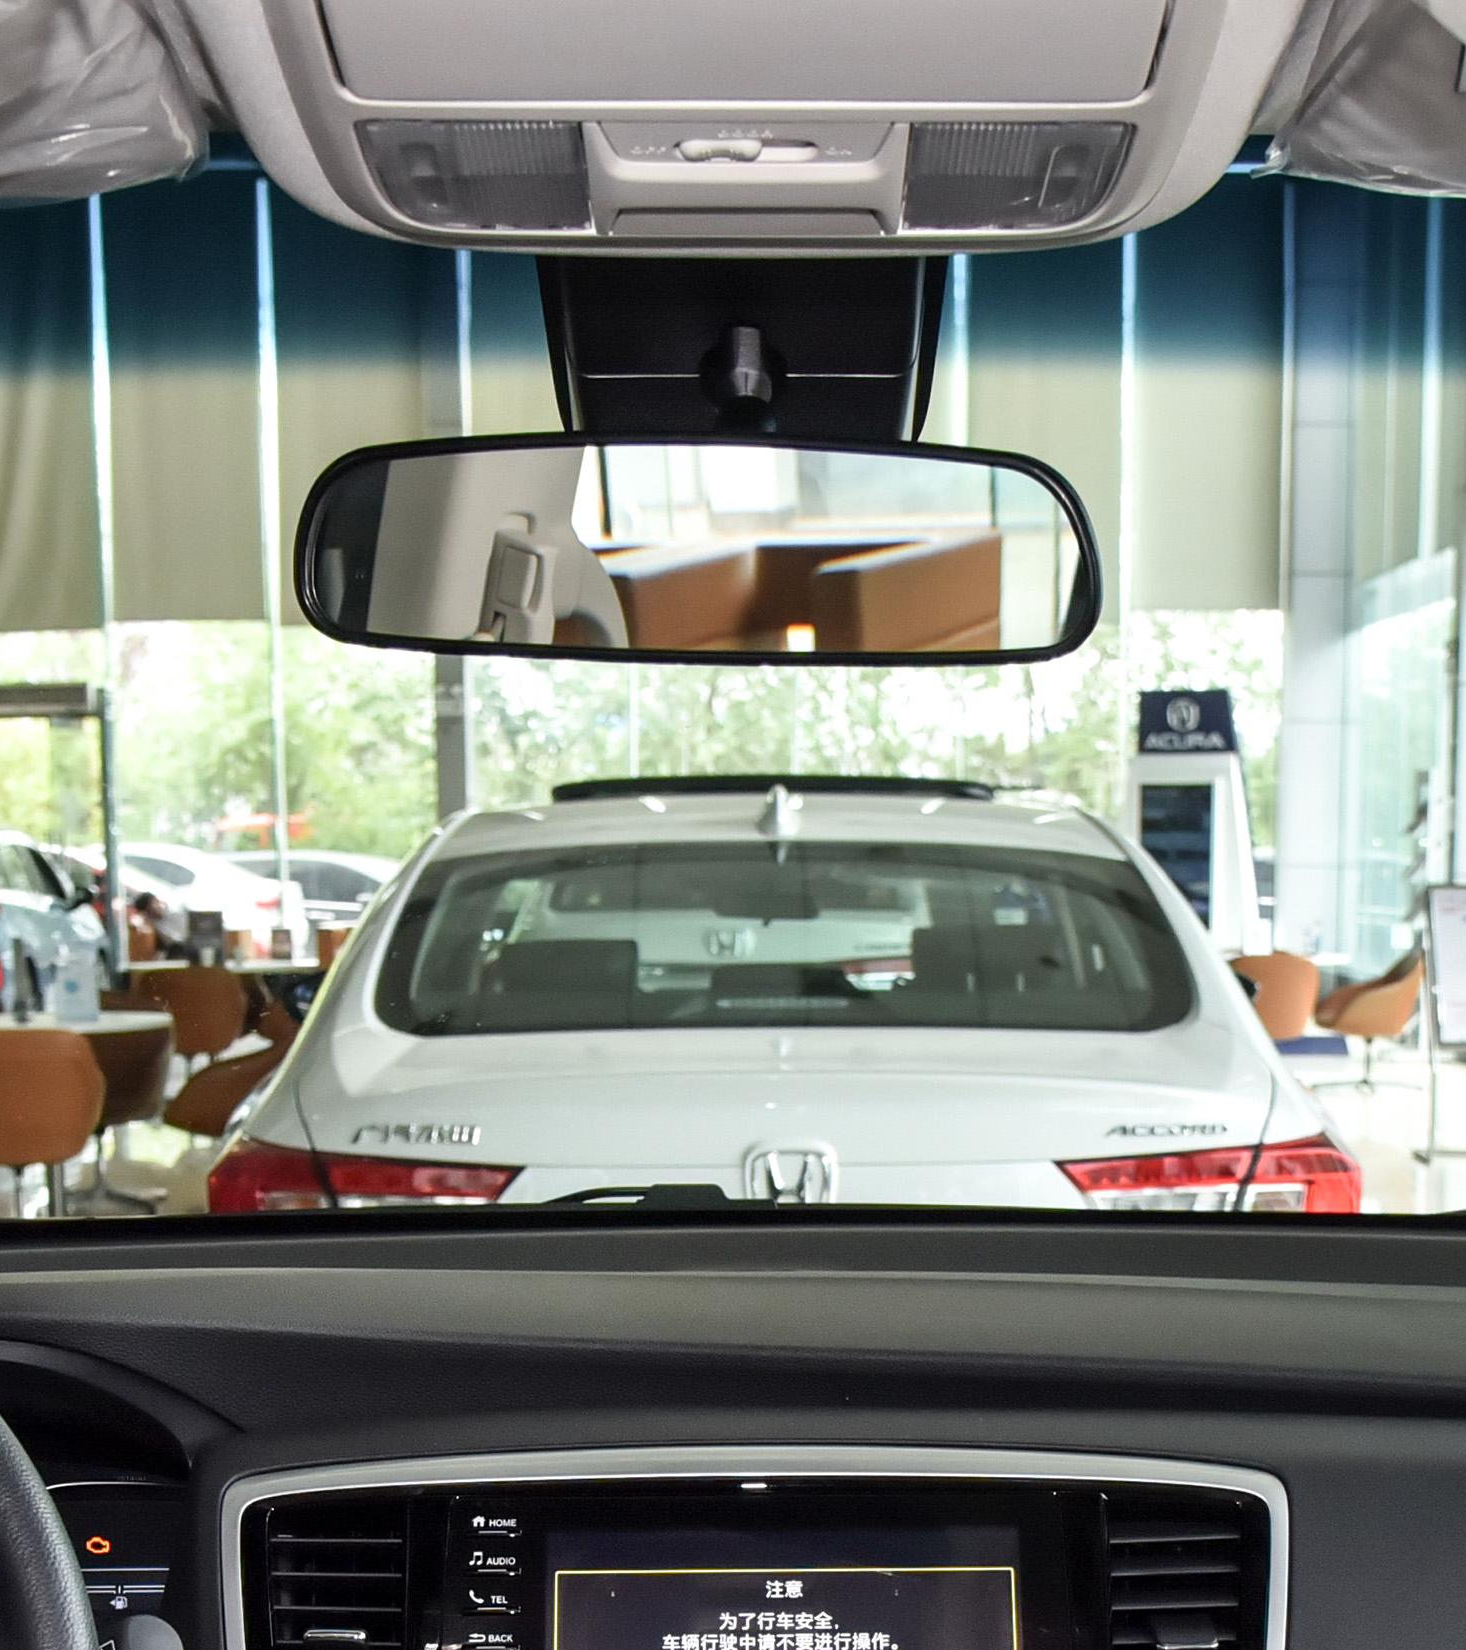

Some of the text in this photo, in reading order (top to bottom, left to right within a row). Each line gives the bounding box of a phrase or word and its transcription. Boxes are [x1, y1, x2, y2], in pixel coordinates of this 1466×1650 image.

[489, 1519, 516, 1527] HOME
[487, 1557, 515, 1565] AUDIO
[766, 1580, 803, 1598] 注意
[491, 1596, 507, 1604] TEL
